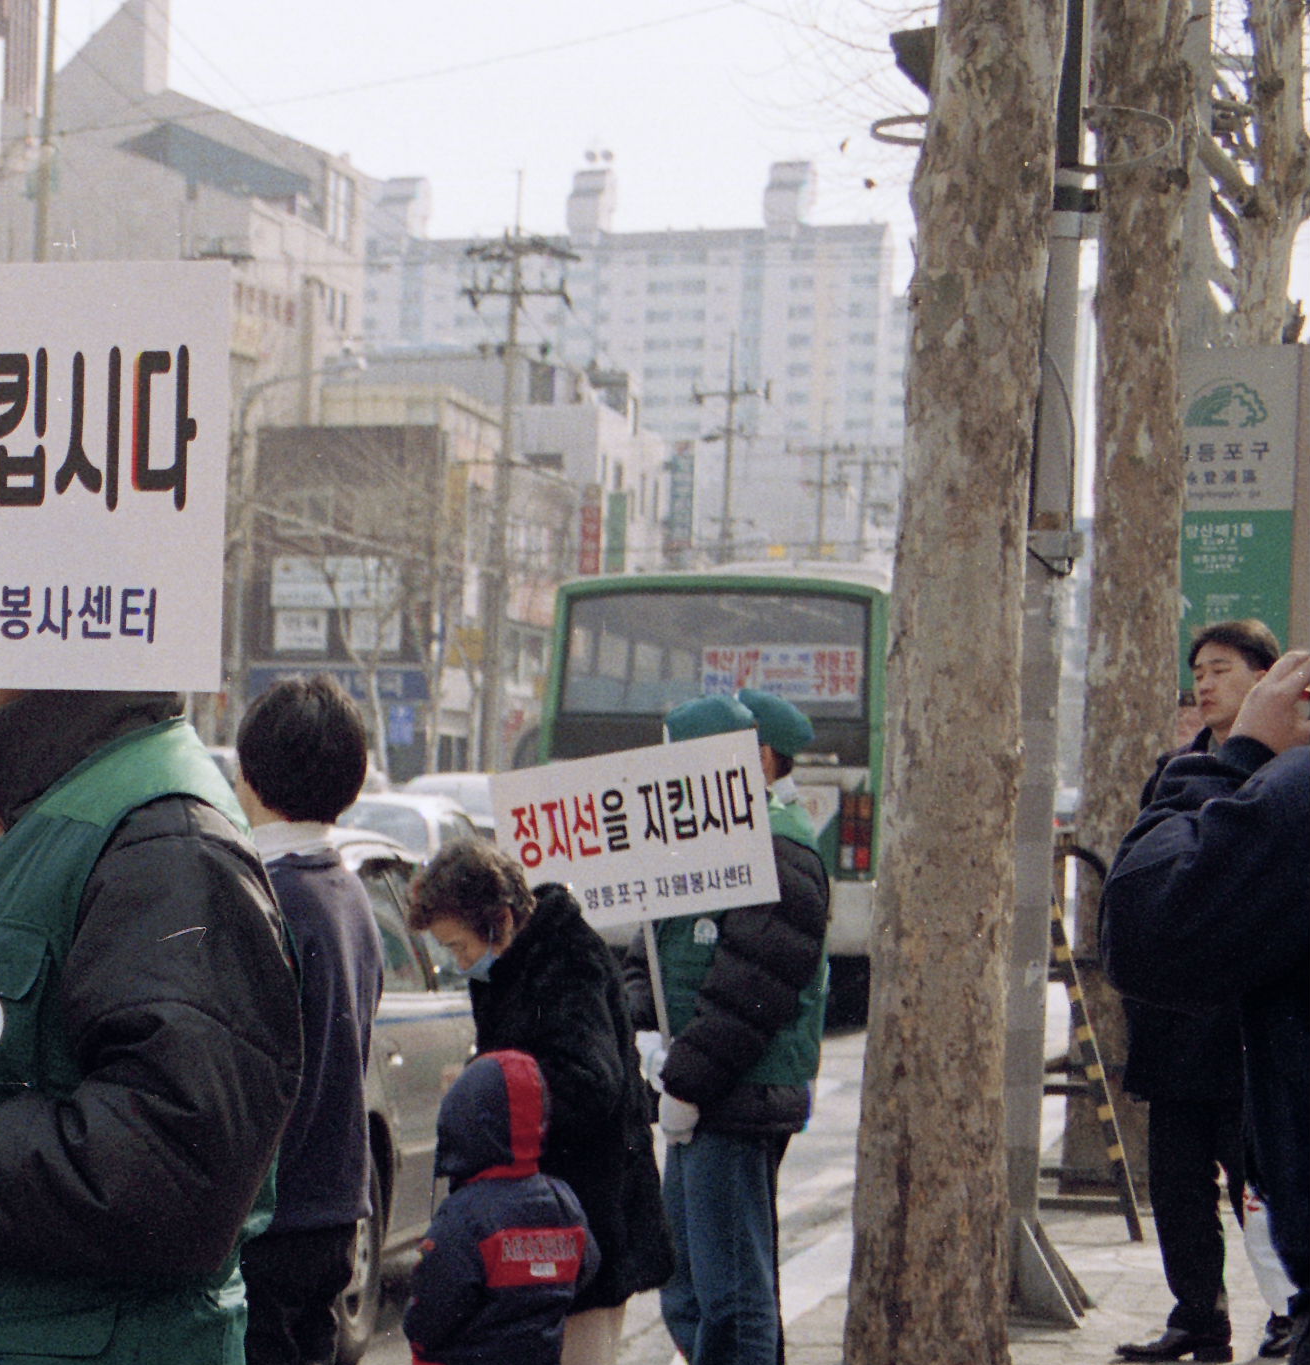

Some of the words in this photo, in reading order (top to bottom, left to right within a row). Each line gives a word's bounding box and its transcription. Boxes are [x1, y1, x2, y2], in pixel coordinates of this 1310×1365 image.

[511, 791, 631, 869] 정지선을
[637, 765, 755, 845] 지킵시다
[583, 879, 647, 910] 영등포구
[654, 863, 753, 898] 자원봉사센터
